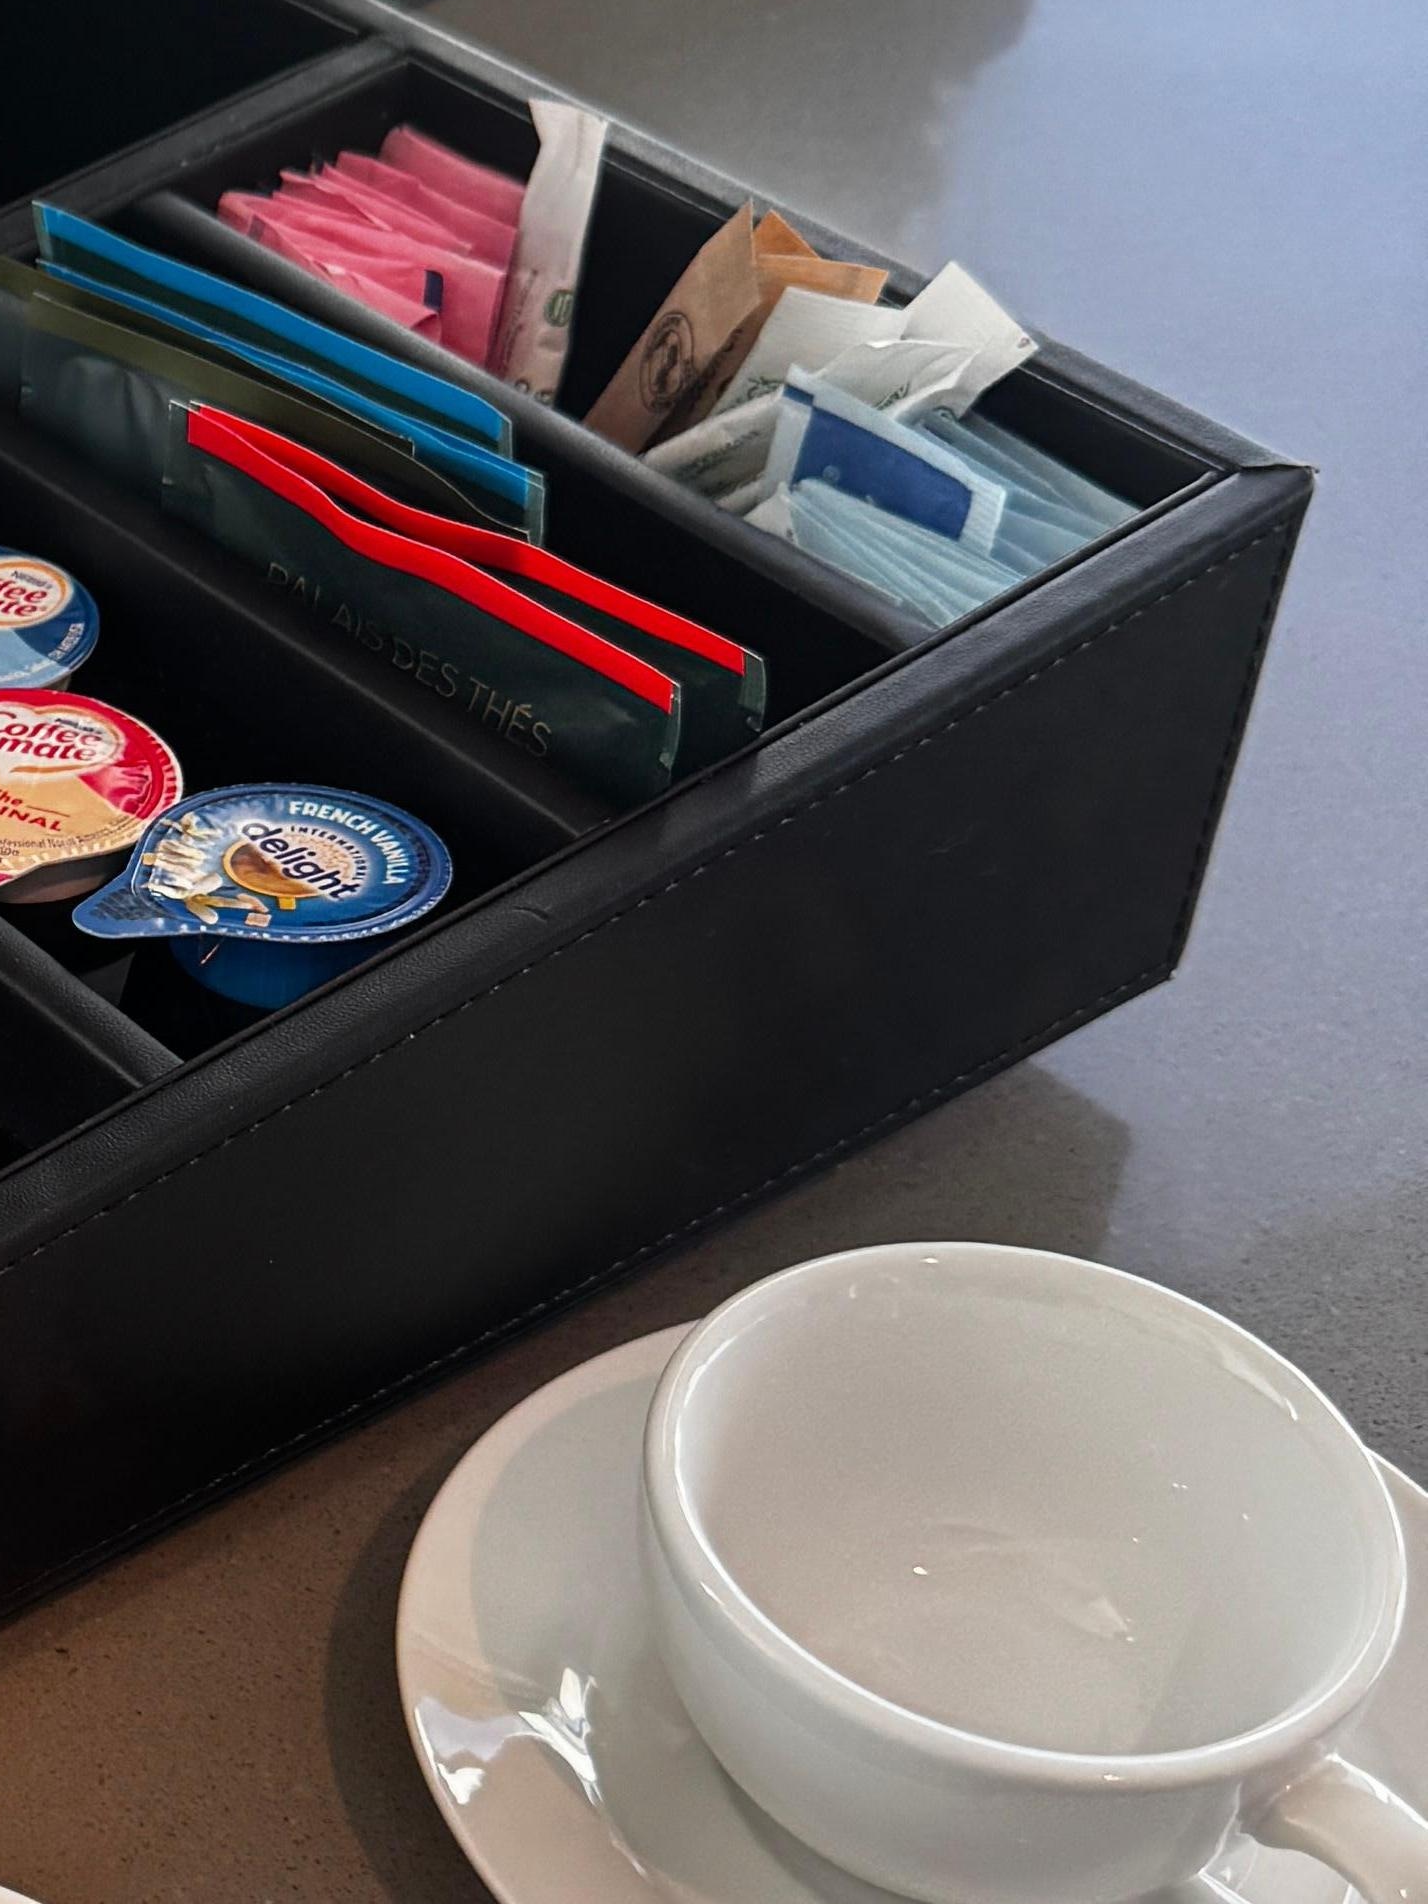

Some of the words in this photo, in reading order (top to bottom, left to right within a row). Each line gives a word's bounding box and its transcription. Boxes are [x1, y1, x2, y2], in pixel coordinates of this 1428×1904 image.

[392, 640, 459, 699] DES
[467, 676, 552, 758] THÉS
[242, 822, 361, 898] delight
[289, 801, 380, 835] FRENCH
[370, 829, 411, 885] VANILLA
[291, 825, 368, 881] INTERNATIONAL
